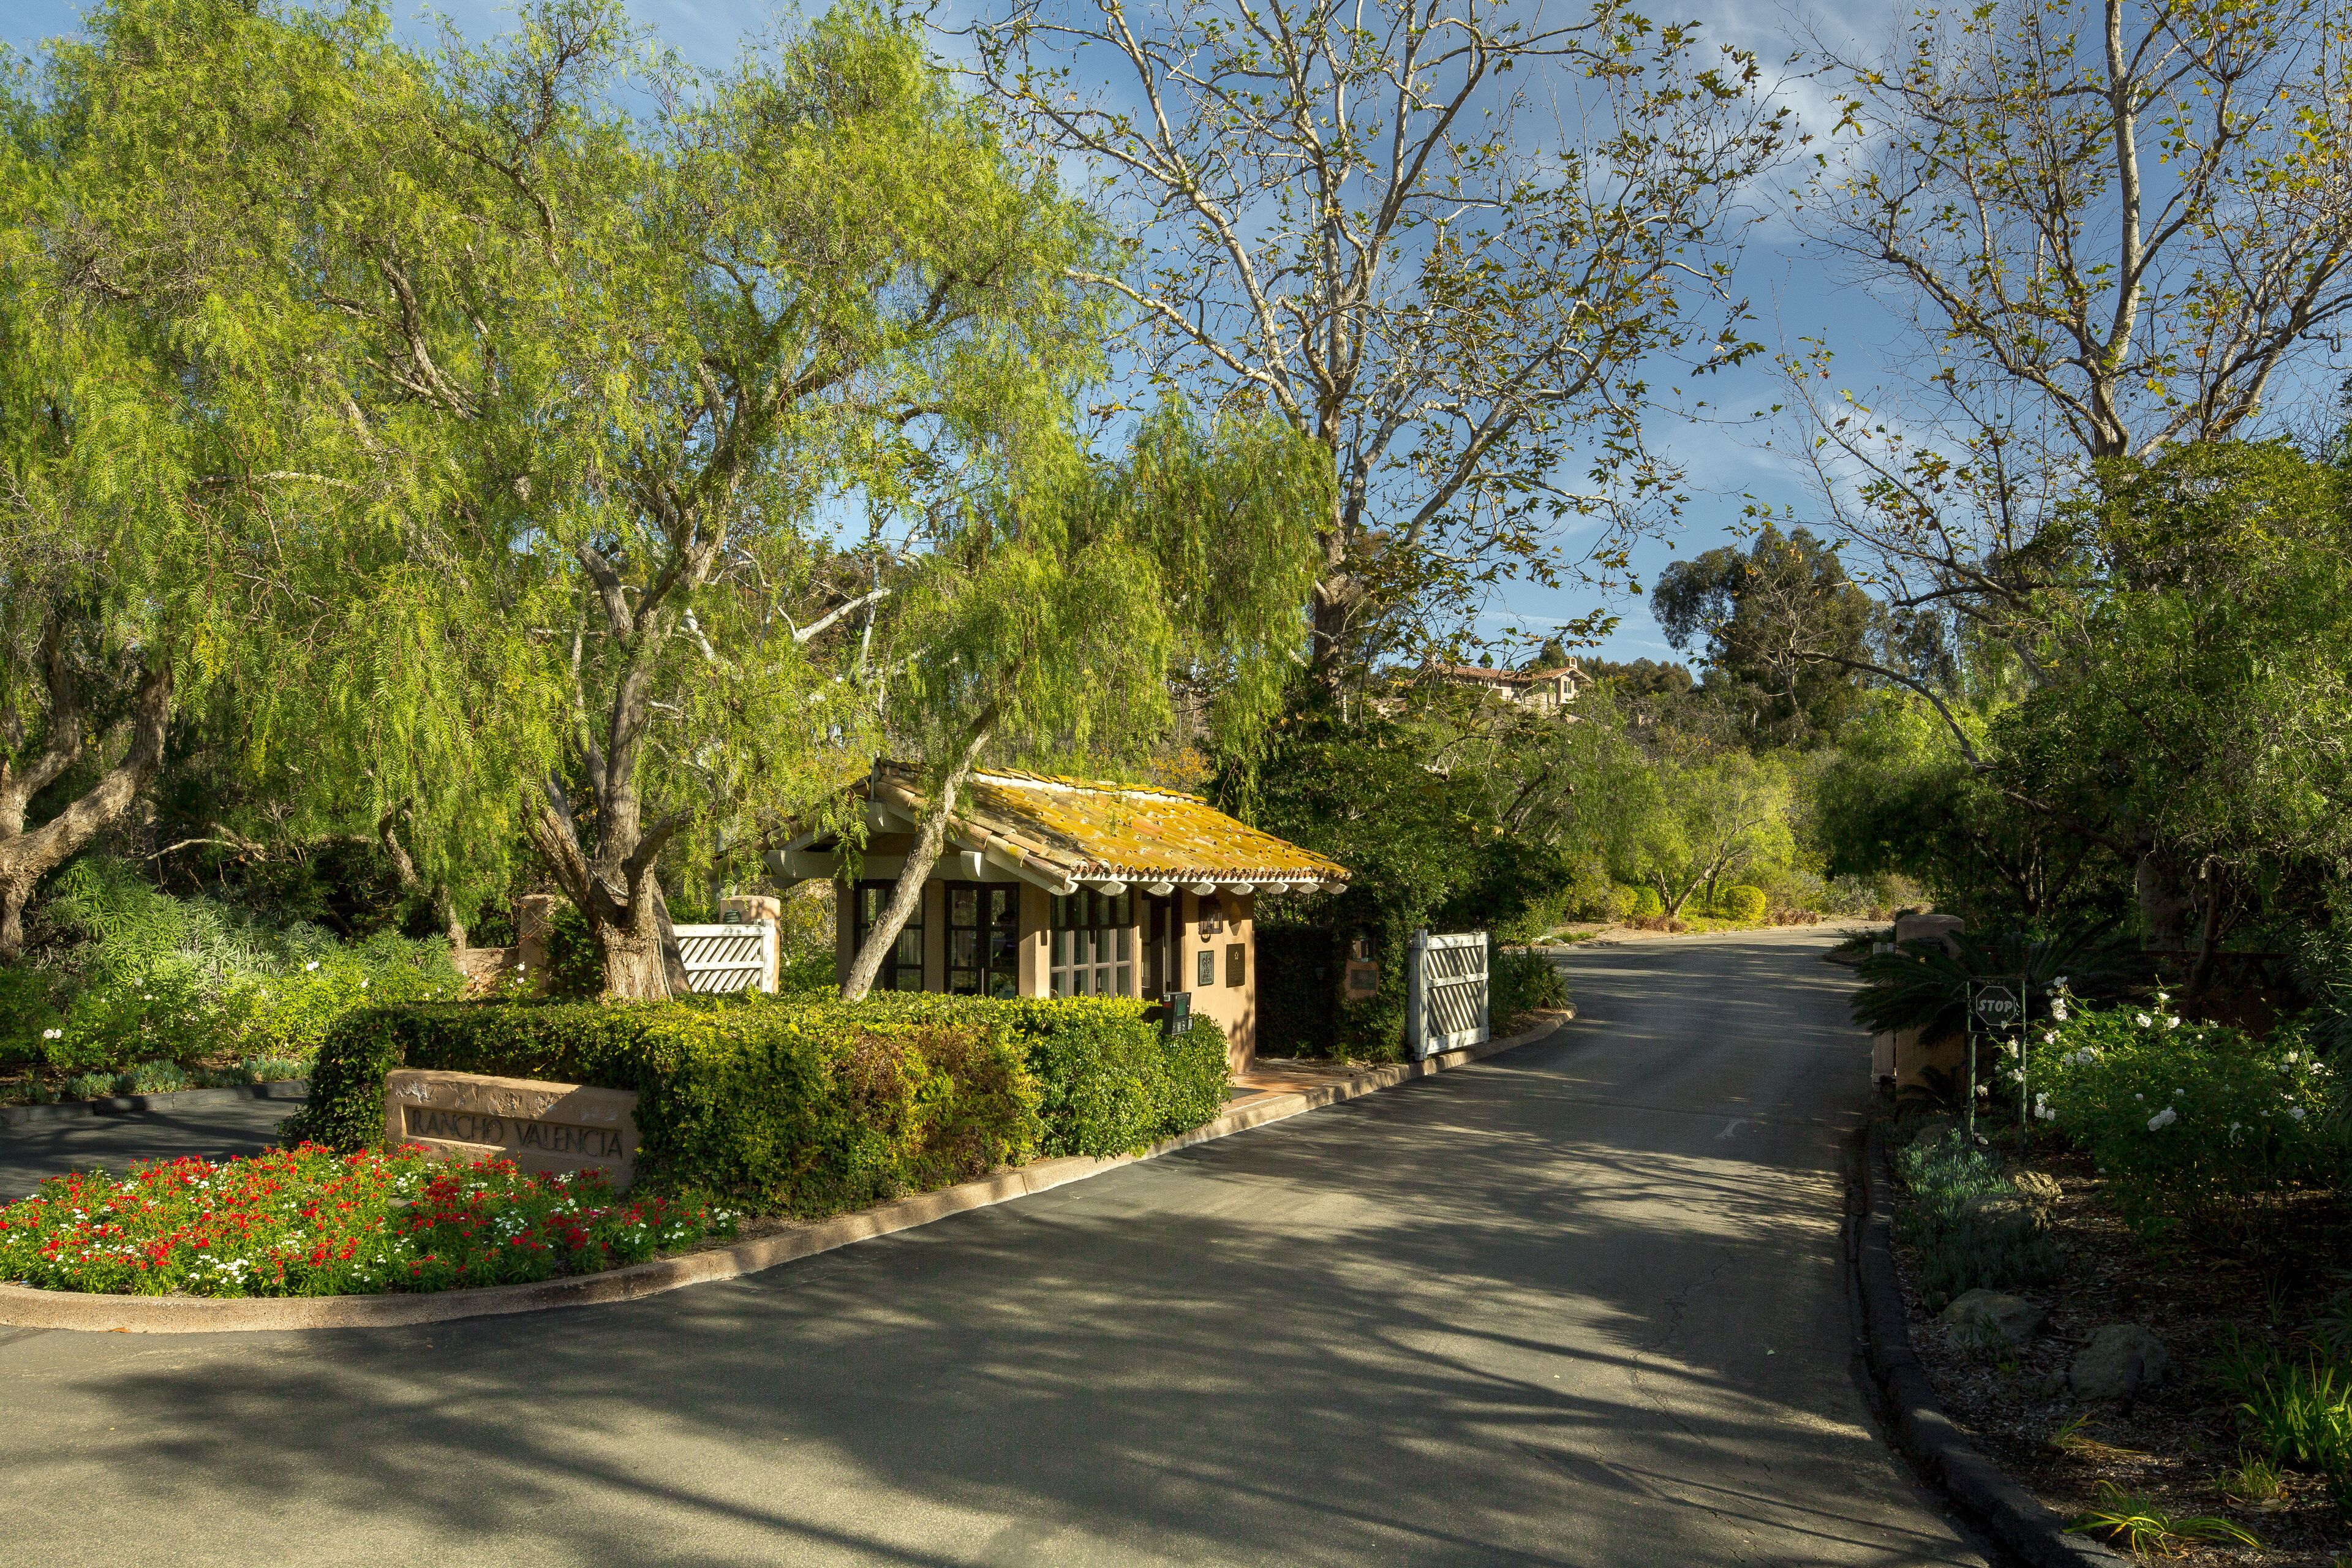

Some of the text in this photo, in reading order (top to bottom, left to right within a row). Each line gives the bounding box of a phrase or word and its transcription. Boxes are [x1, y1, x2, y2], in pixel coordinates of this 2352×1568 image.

[1978, 999, 2013, 1012] STOP
[412, 1109, 623, 1158] RANCHO VALENCIA
